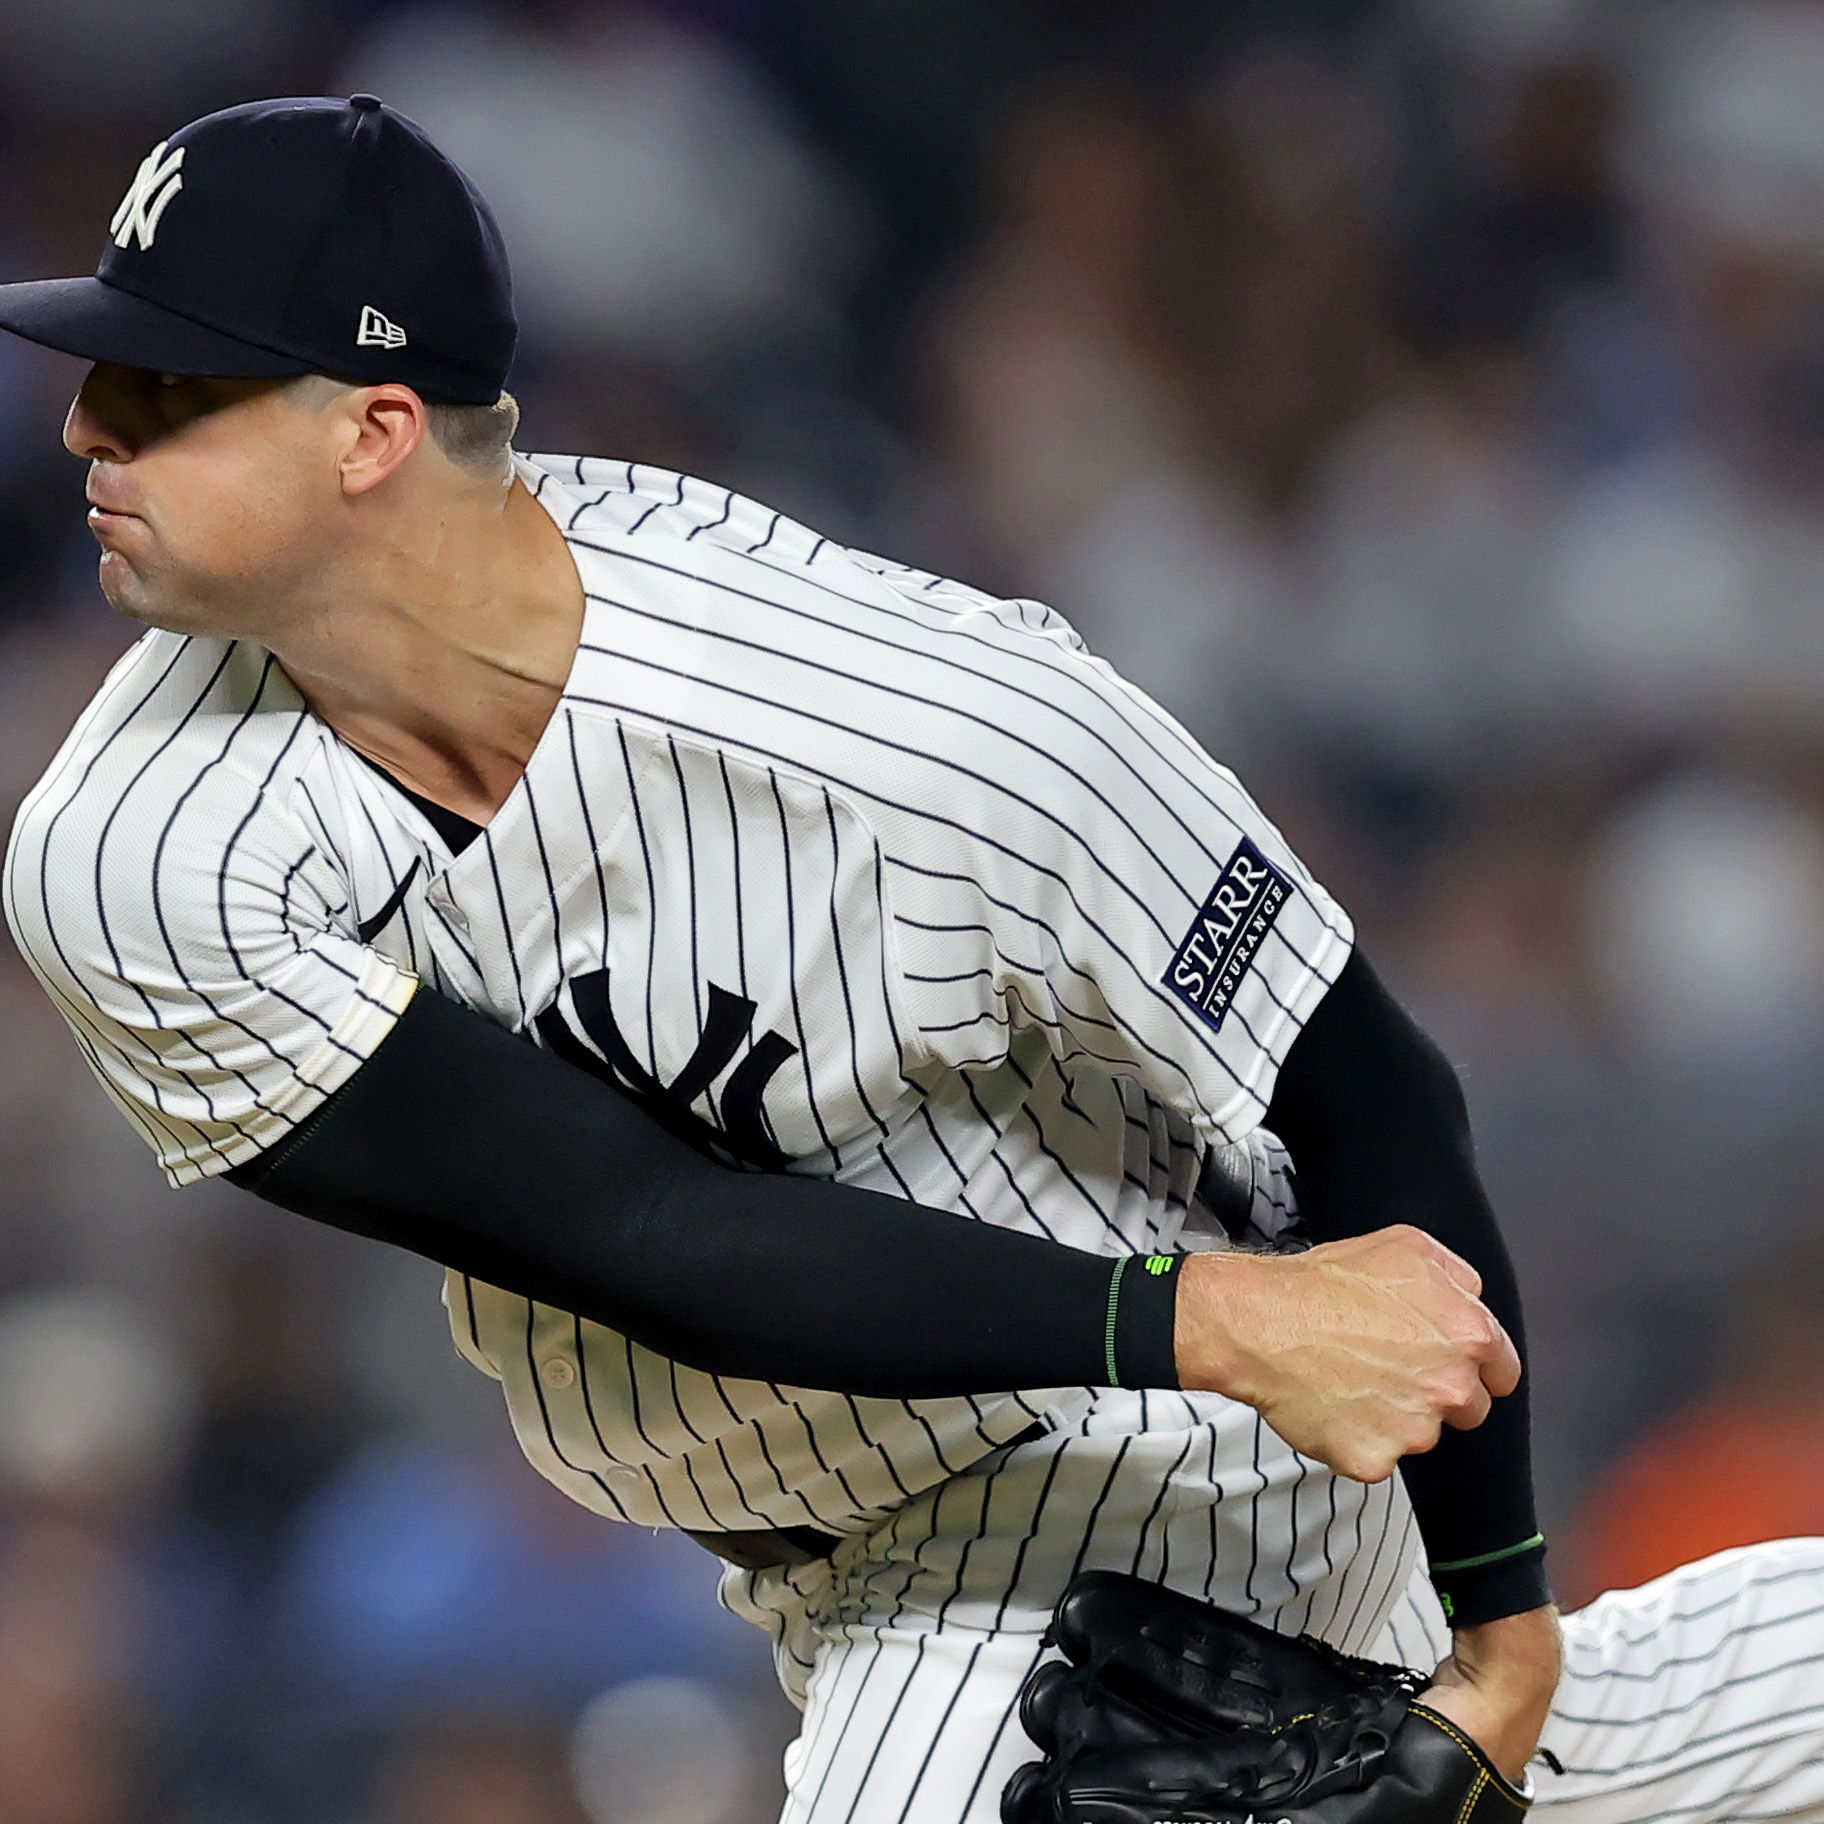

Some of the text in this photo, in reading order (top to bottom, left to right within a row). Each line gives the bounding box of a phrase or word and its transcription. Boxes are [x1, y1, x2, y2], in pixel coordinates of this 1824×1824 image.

[110, 141, 184, 251] NY
[1174, 856, 1268, 1002] STARR
[1208, 885, 1284, 1018] INSURANCE
